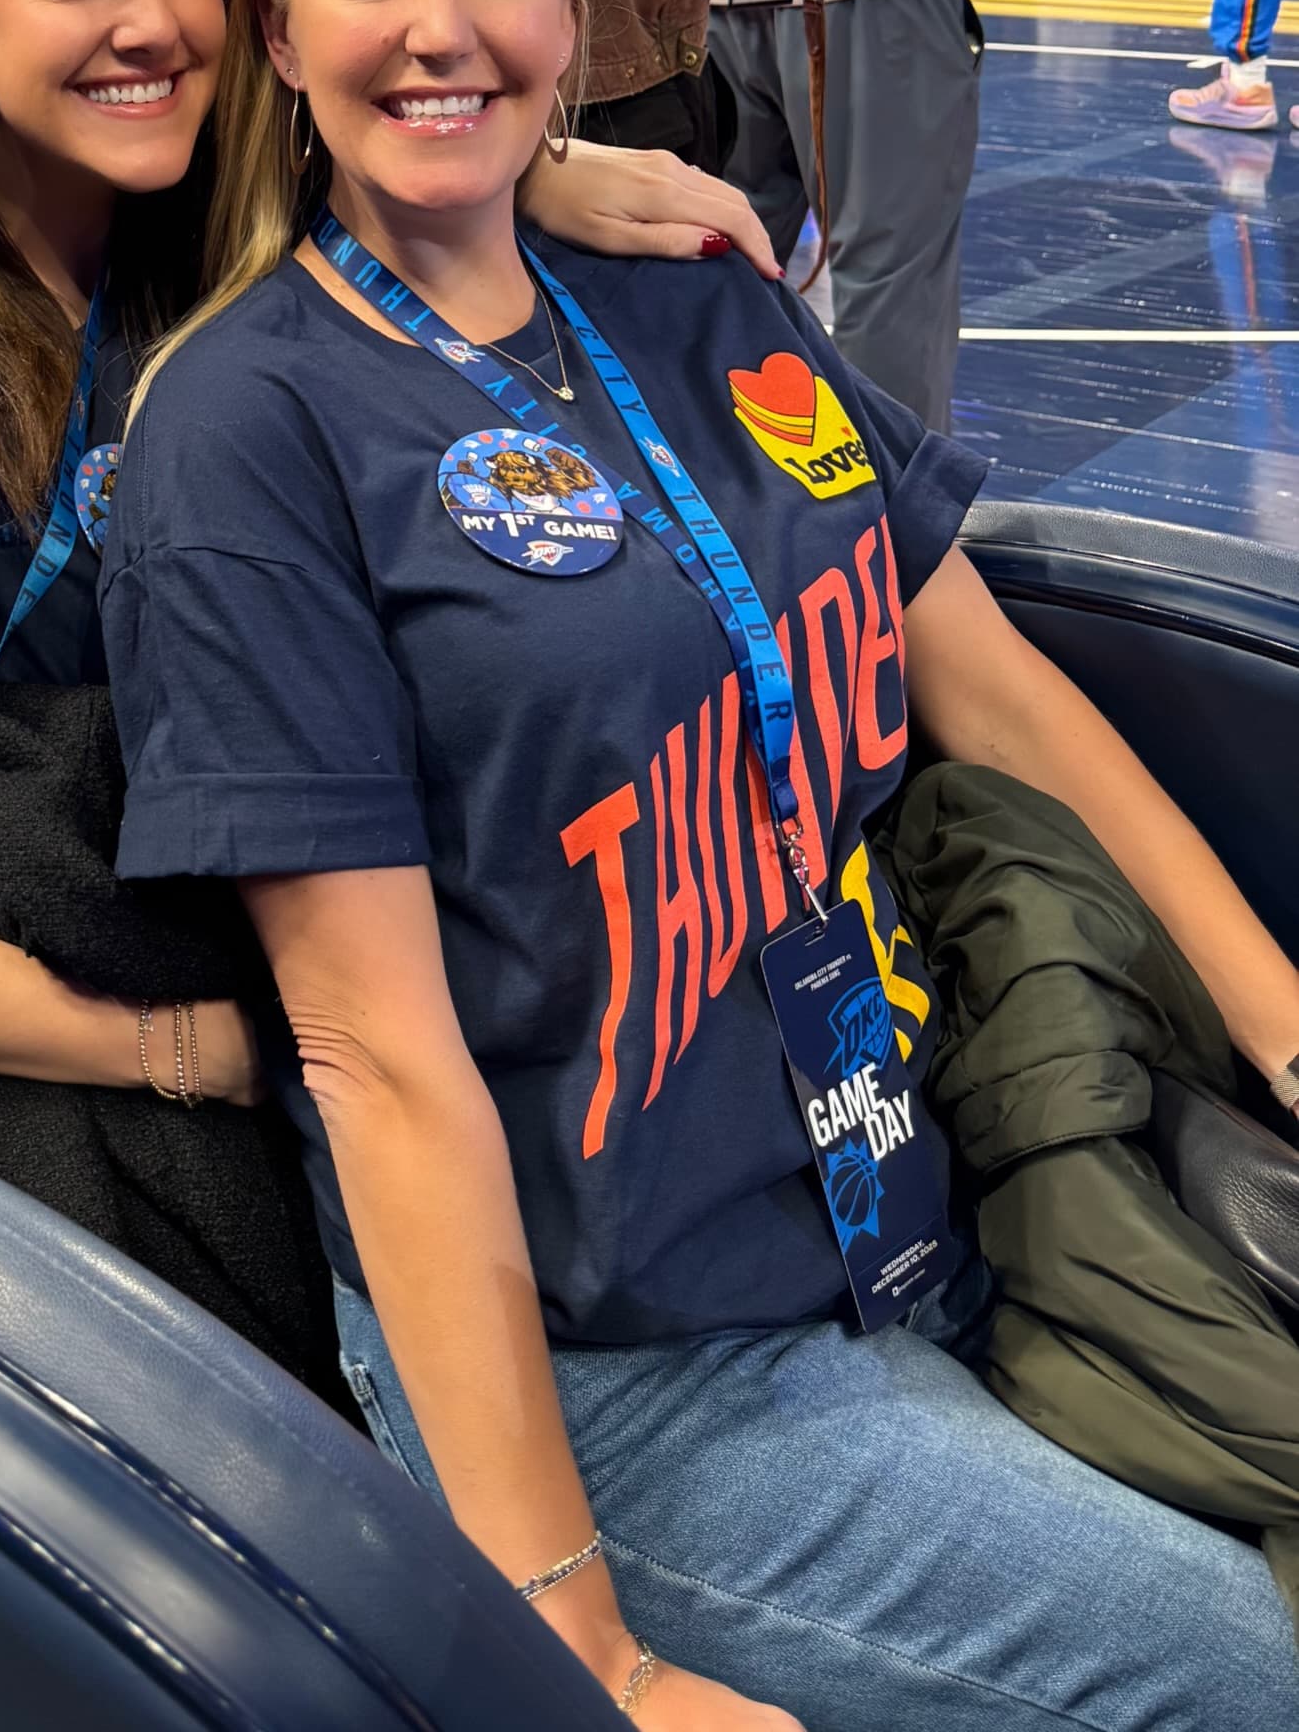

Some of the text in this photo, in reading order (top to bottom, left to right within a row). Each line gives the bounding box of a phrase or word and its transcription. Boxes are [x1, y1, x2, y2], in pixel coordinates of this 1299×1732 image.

[574, 324, 647, 416] CITY
[461, 512, 618, 541] MY 1ST GAME!
[672, 490, 795, 723] THUNDER
[807, 1061, 887, 1148] GAME
[863, 1089, 915, 1162] DAY
[871, 1260, 911, 1295] DECEMBER
[919, 1239, 939, 1258] 2025
